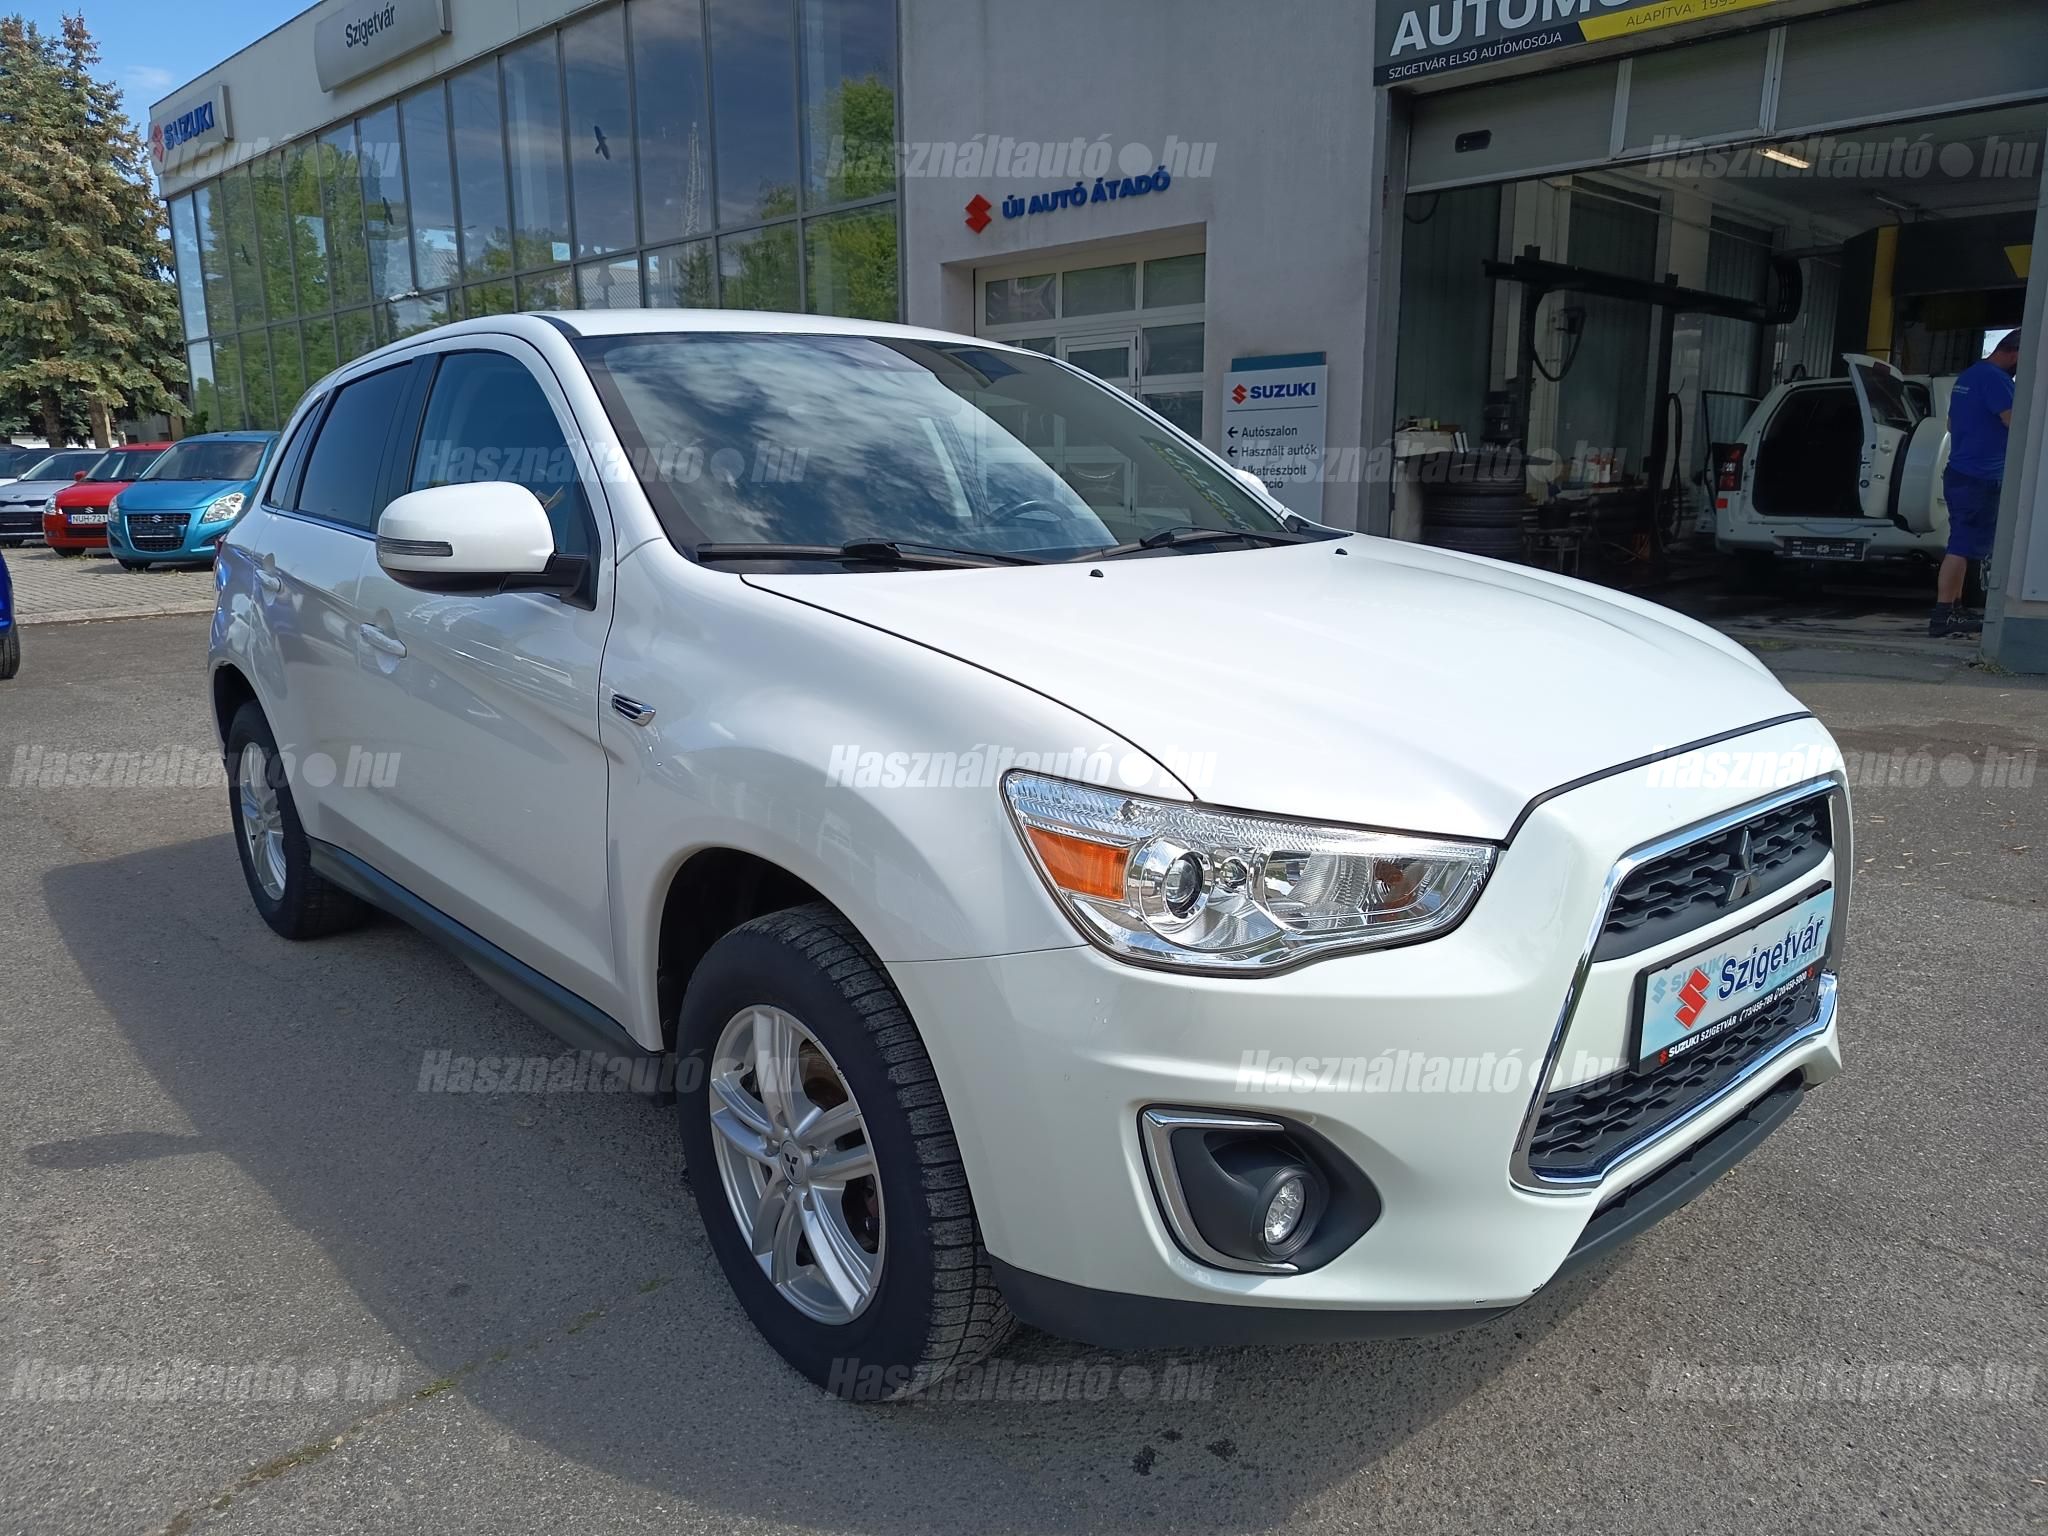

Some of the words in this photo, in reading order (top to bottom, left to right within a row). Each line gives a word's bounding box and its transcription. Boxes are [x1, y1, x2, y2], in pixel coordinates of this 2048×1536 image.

[345, 3, 396, 49] Szigetvár
[1388, 56, 1446, 79] SZIGETVÁR
[1449, 48, 1478, 66] ELSŐ
[1480, 31, 1563, 60] AUTÓMOSÓJA
[164, 101, 214, 150] SUZUKI
[1002, 194, 1025, 219] ÚJ
[1028, 181, 1088, 214] AUTÓ
[1250, 382, 1316, 400] SUZUKI
[1241, 425, 1298, 438] Autószalon
[1241, 445, 1285, 457] Használt
[1287, 444, 1317, 456] autók
[1718, 914, 1824, 1000] Szigetvár
[1668, 1034, 1700, 1058] SUZUKI
[1700, 1015, 1737, 1041] SZIGETVÁR
